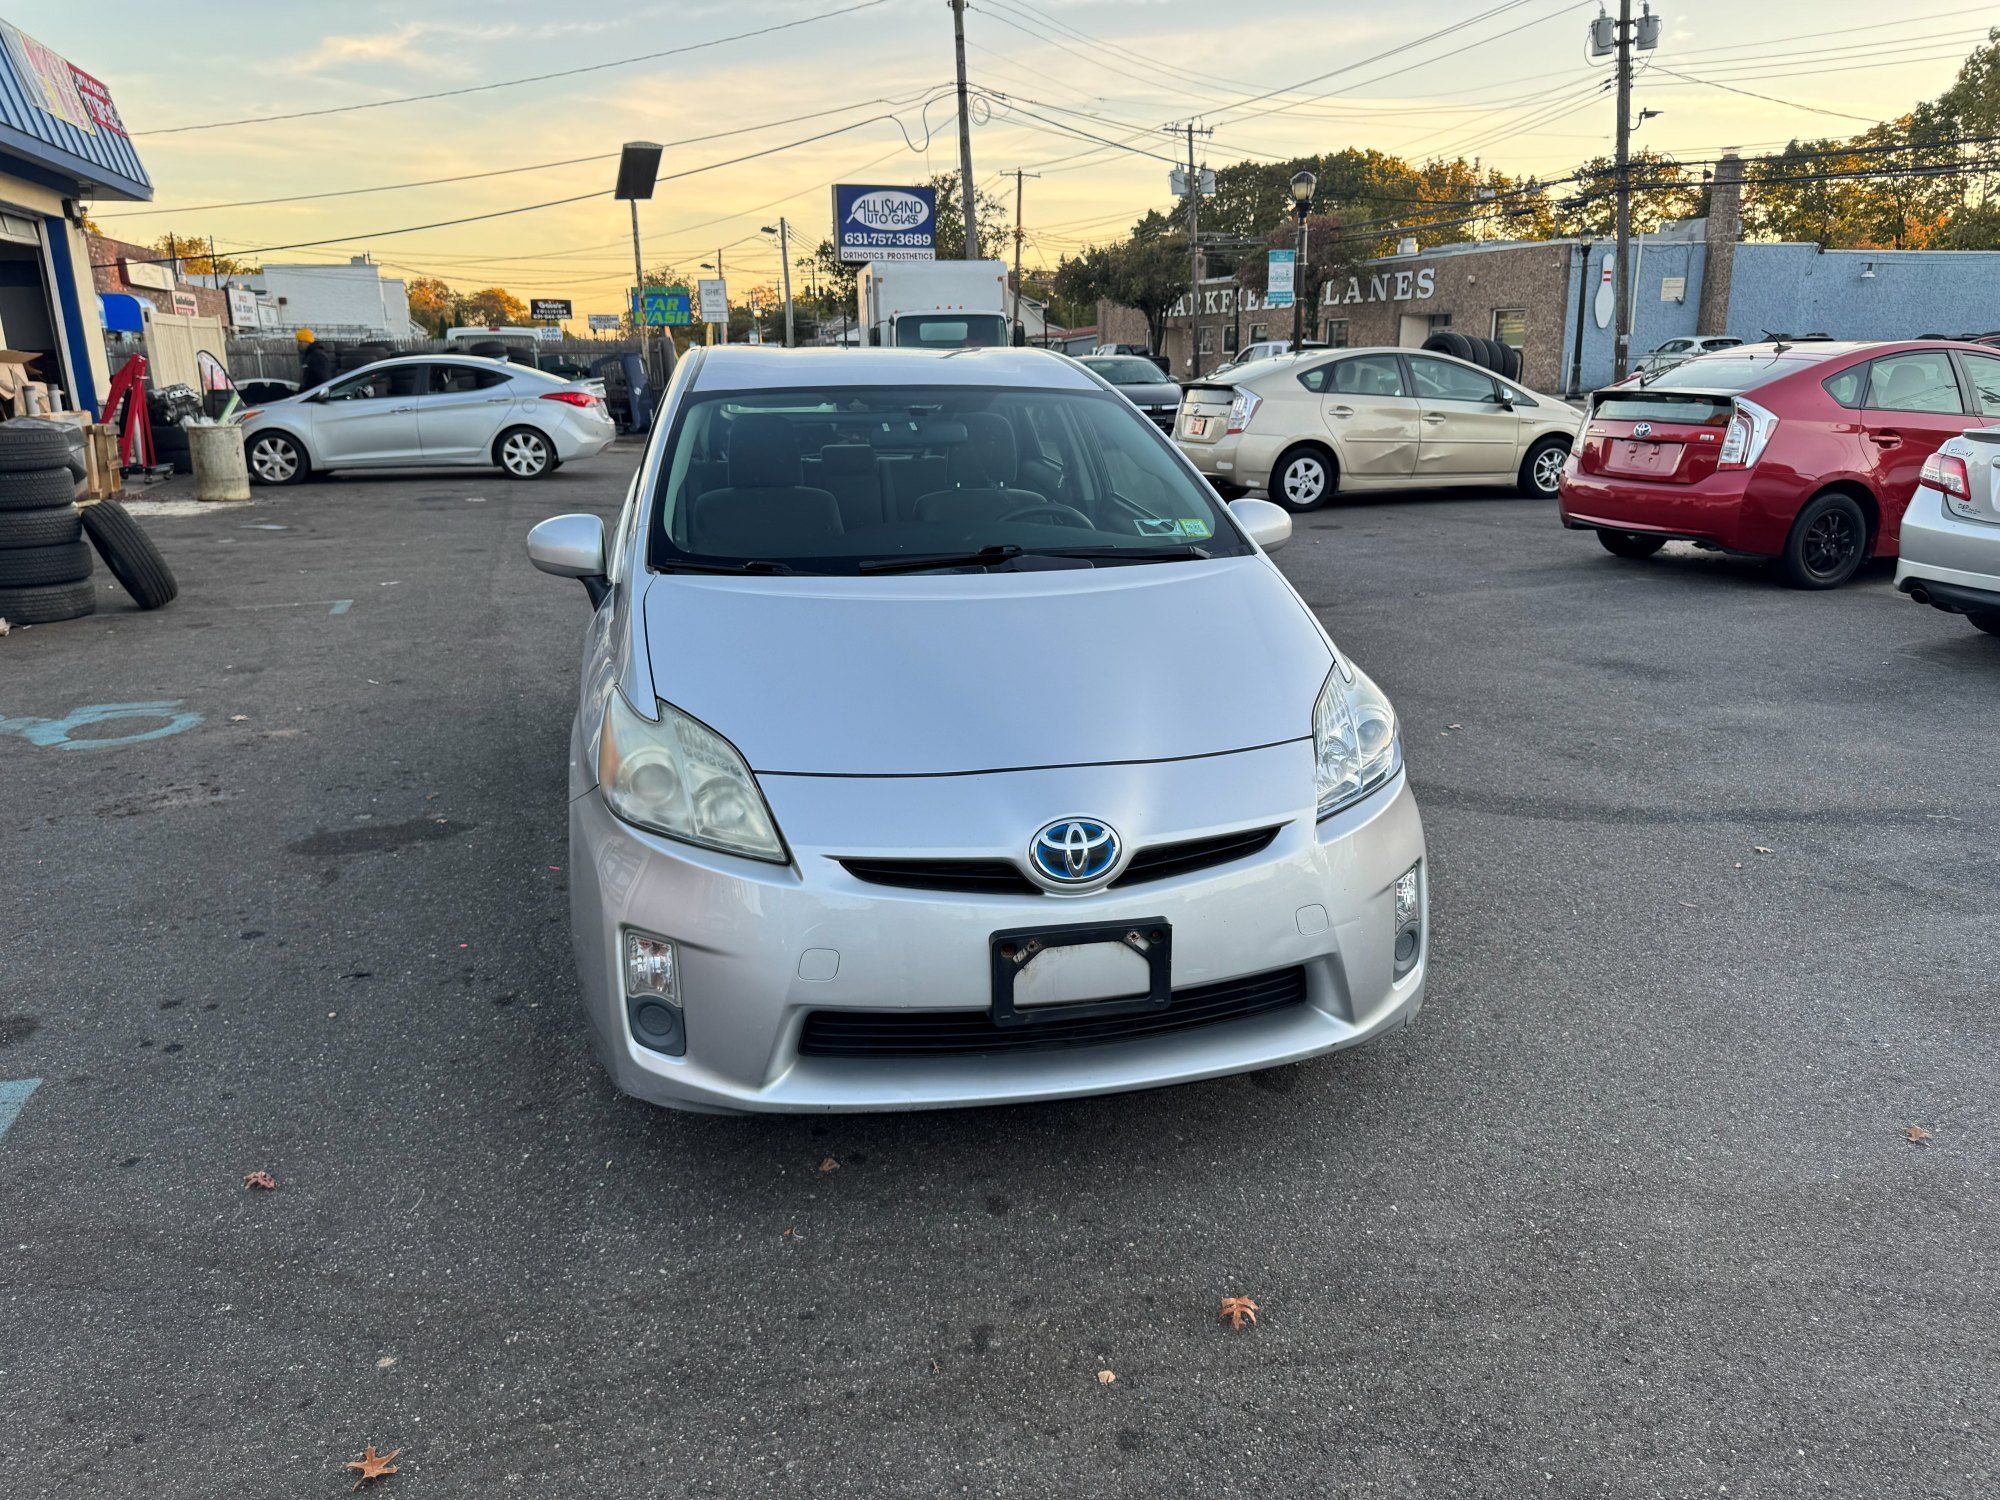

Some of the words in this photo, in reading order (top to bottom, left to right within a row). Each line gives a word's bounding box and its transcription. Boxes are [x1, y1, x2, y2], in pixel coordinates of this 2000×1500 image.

[853, 199, 879, 215] ALL
[881, 198, 923, 216] ISLAND
[891, 213, 918, 225] GLASS
[844, 232, 931, 246] 631-757-3689
[843, 251, 884, 260] ORTHOTICS
[887, 252, 933, 260] PROSTHETICS
[1322, 267, 1436, 306] LANES
[643, 298, 679, 311] CAR
[635, 311, 689, 325] WASH
